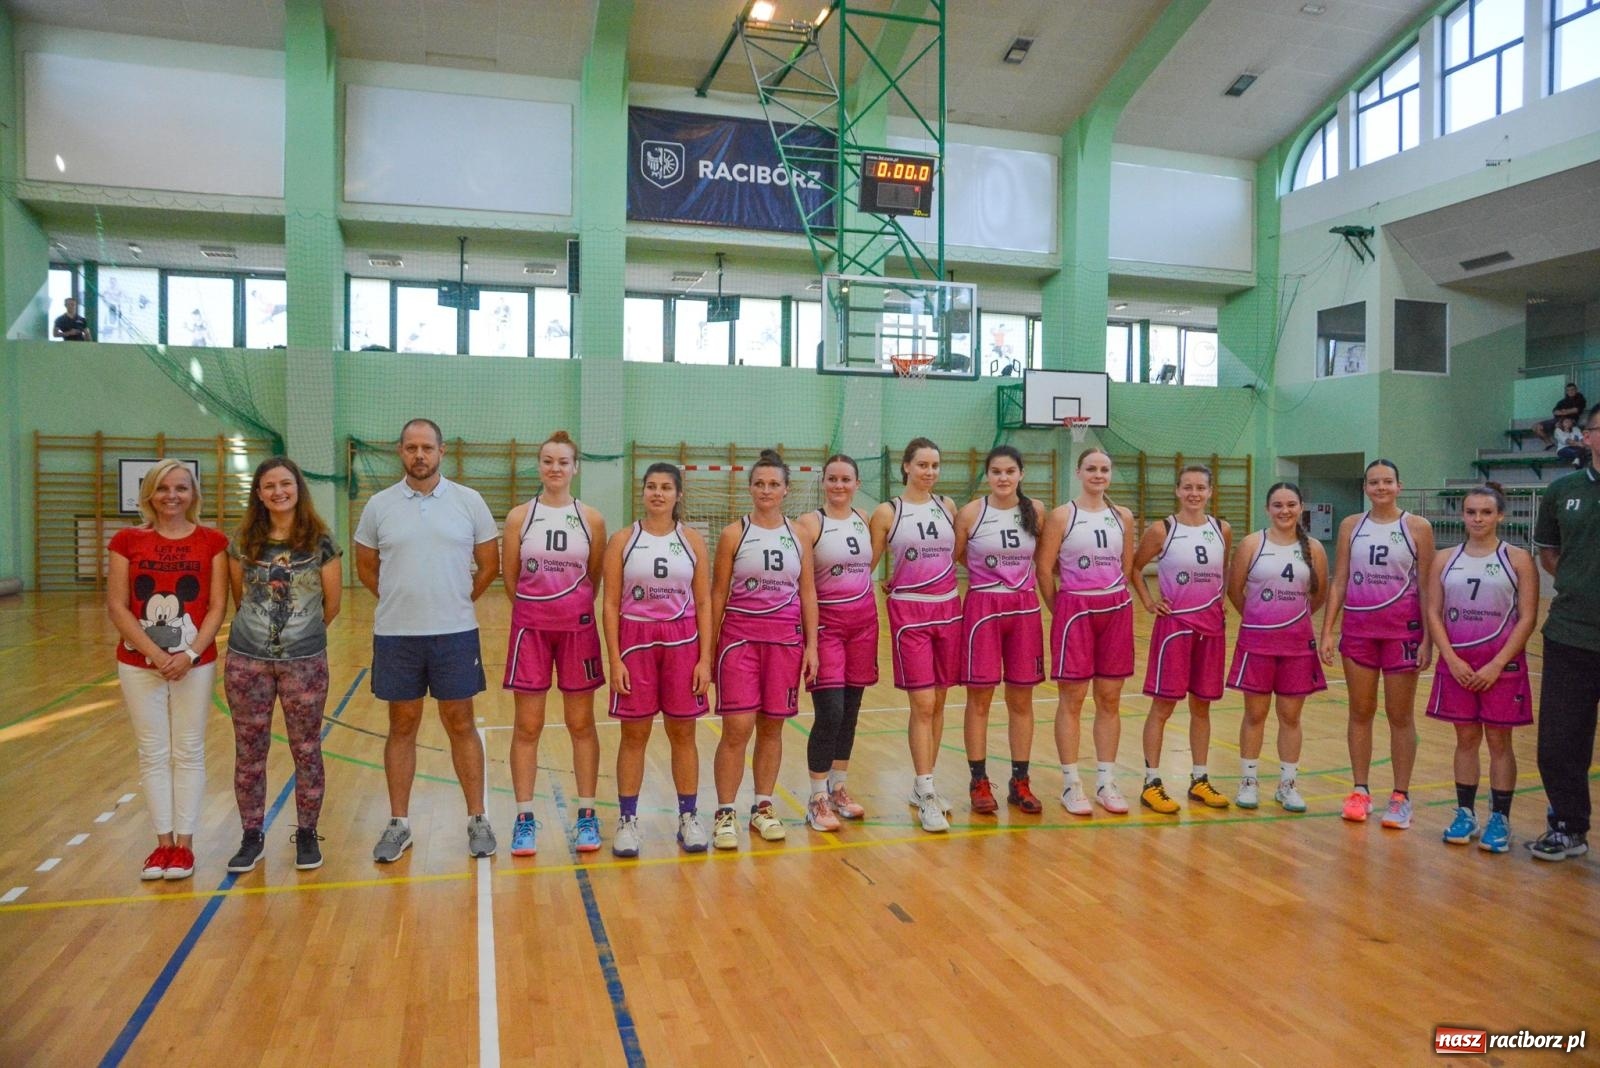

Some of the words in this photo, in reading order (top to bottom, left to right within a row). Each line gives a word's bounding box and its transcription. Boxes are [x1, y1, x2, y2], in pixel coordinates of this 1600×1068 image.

[698, 160, 822, 190] RACIBÓRZ
[1565, 498, 1581, 511] PJ
[545, 529, 568, 552] 10
[917, 521, 939, 540] 14
[1000, 529, 1021, 549] 15
[1094, 529, 1108, 549] 11
[155, 544, 173, 553] LET
[846, 536, 861, 556] 9
[1194, 545, 1209, 565] 8
[1369, 544, 1389, 566] 12
[159, 552, 186, 561] TAKE
[762, 549, 784, 572] 13
[653, 557, 669, 579] 6
[1280, 562, 1295, 583] 4
[1466, 578, 1481, 601] 7
